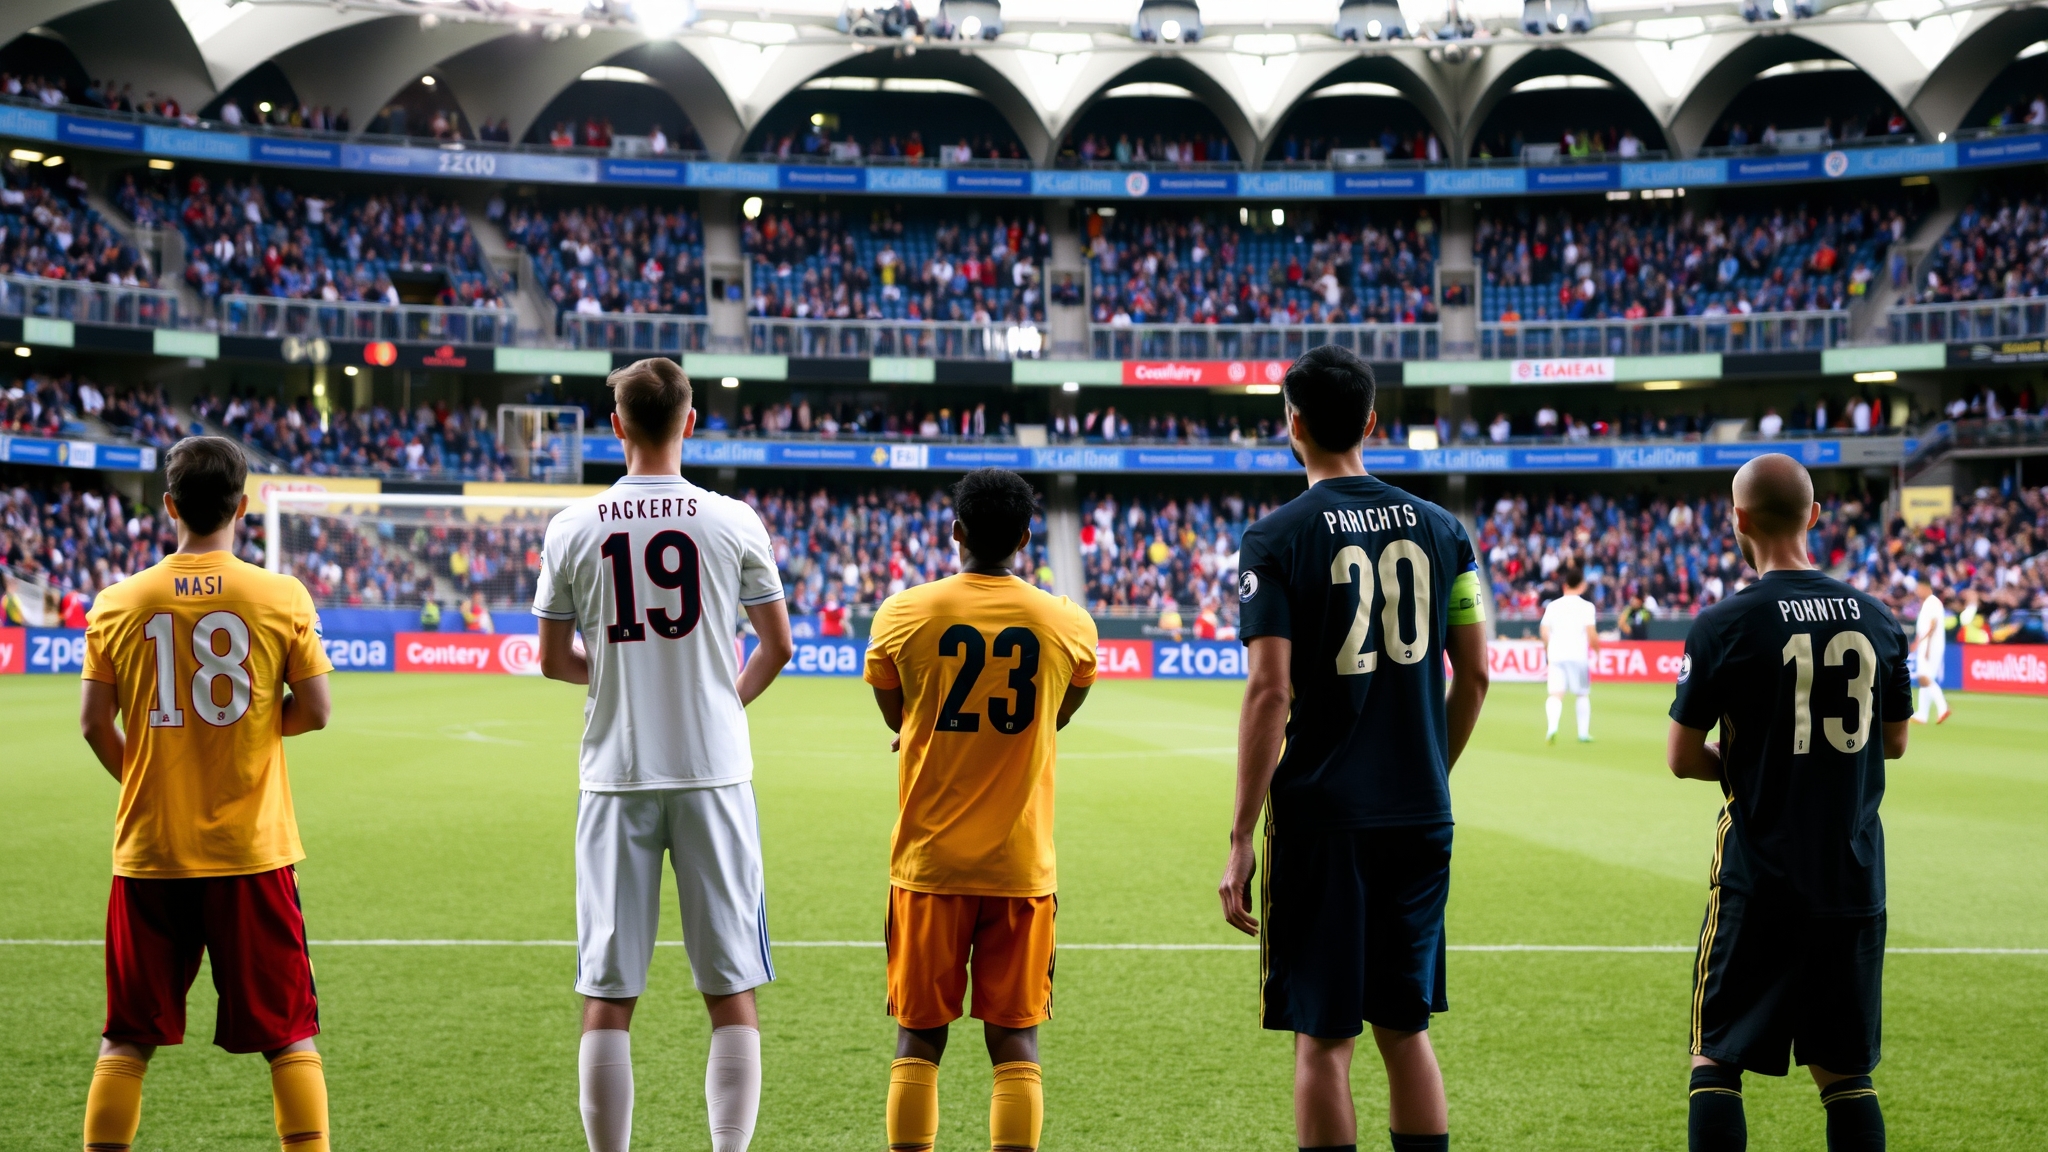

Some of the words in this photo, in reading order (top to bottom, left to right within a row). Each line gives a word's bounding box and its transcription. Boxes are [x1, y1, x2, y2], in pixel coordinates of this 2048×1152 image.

[174, 575, 222, 596] MASI
[601, 529, 701, 644] 19
[1331, 539, 1430, 675] 20
[143, 610, 251, 728] 18
[935, 624, 1040, 734] 23
[1782, 630, 1877, 755] 13
